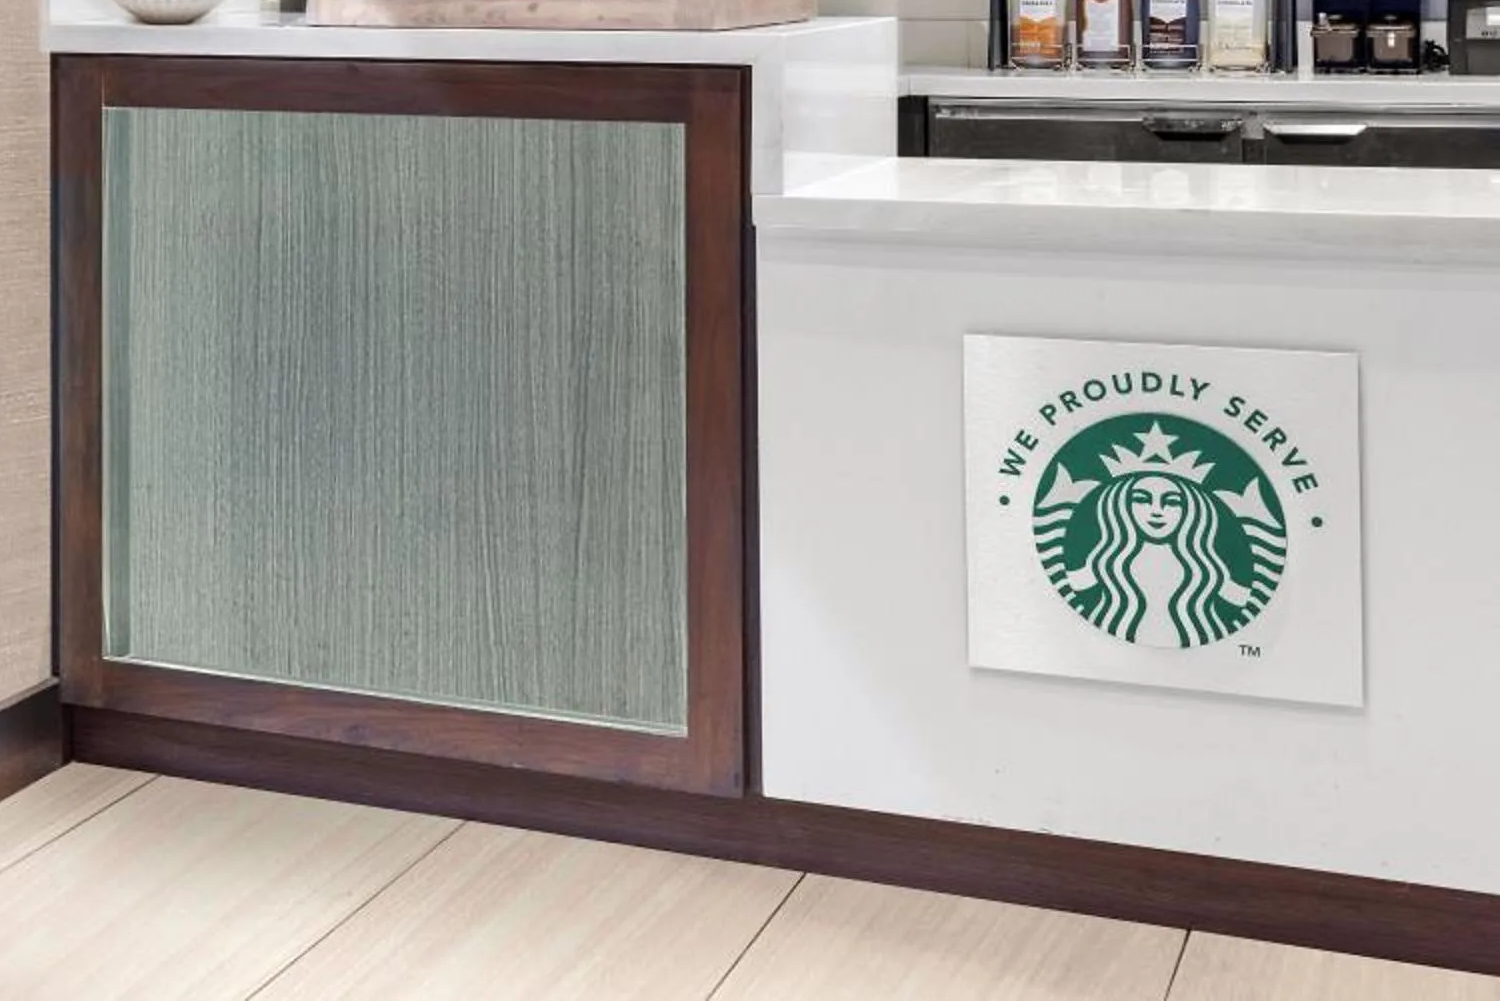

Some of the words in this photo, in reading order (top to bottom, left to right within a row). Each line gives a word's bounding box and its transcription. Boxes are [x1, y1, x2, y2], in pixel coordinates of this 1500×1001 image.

[999, 430, 1039, 479] WE
[1039, 372, 1210, 426] PROUDLY
[1223, 396, 1318, 494] SERVE
[1239, 644, 1261, 658] TM
